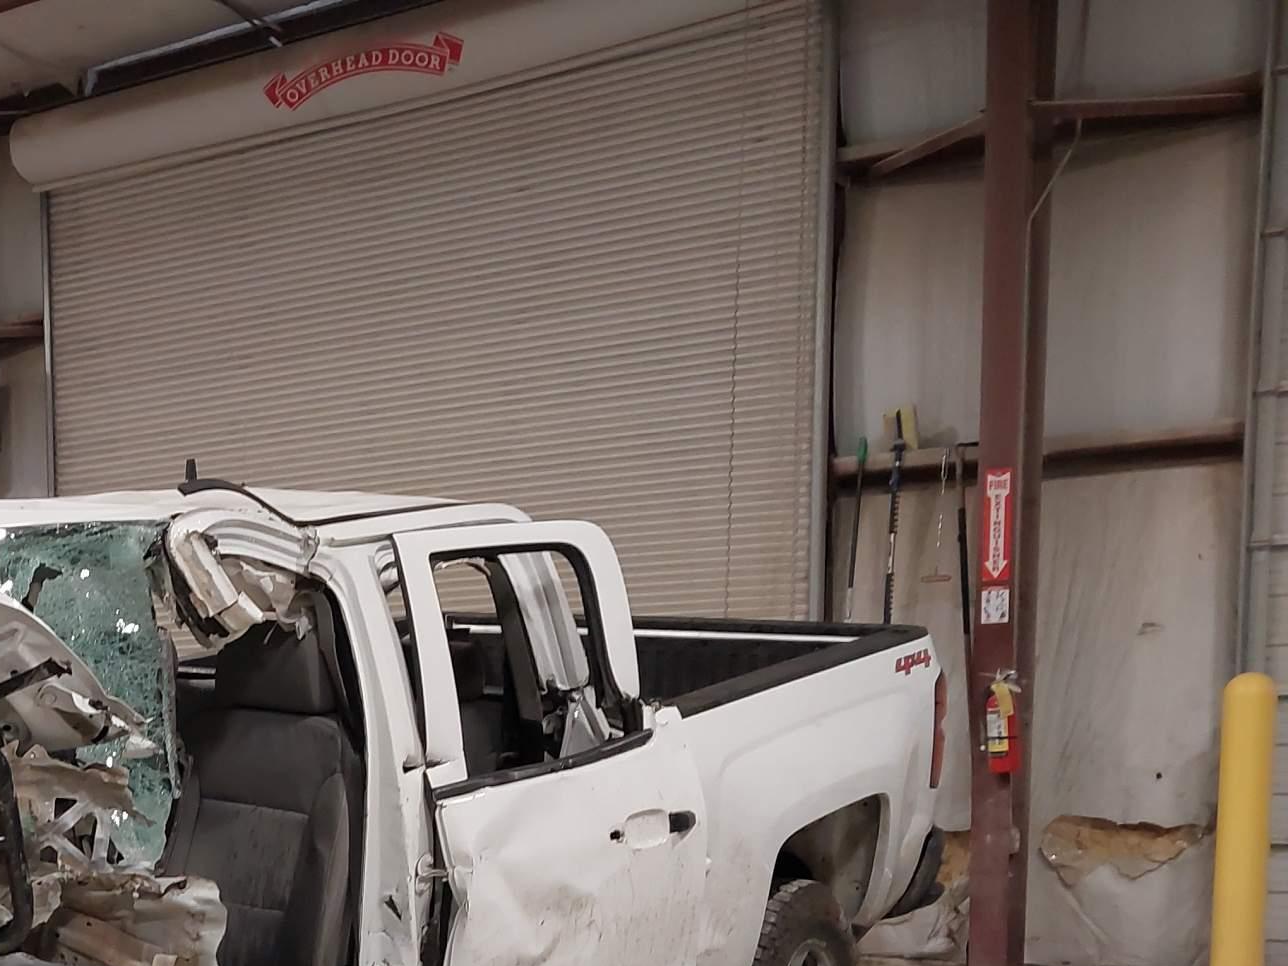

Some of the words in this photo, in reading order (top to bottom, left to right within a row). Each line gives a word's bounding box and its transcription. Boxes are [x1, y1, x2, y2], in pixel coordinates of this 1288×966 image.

[285, 51, 383, 104] OVERHEAD
[388, 48, 442, 71] DOOR
[988, 479, 1010, 491] FIRE
[991, 493, 1003, 573] EXTINGUISHER
